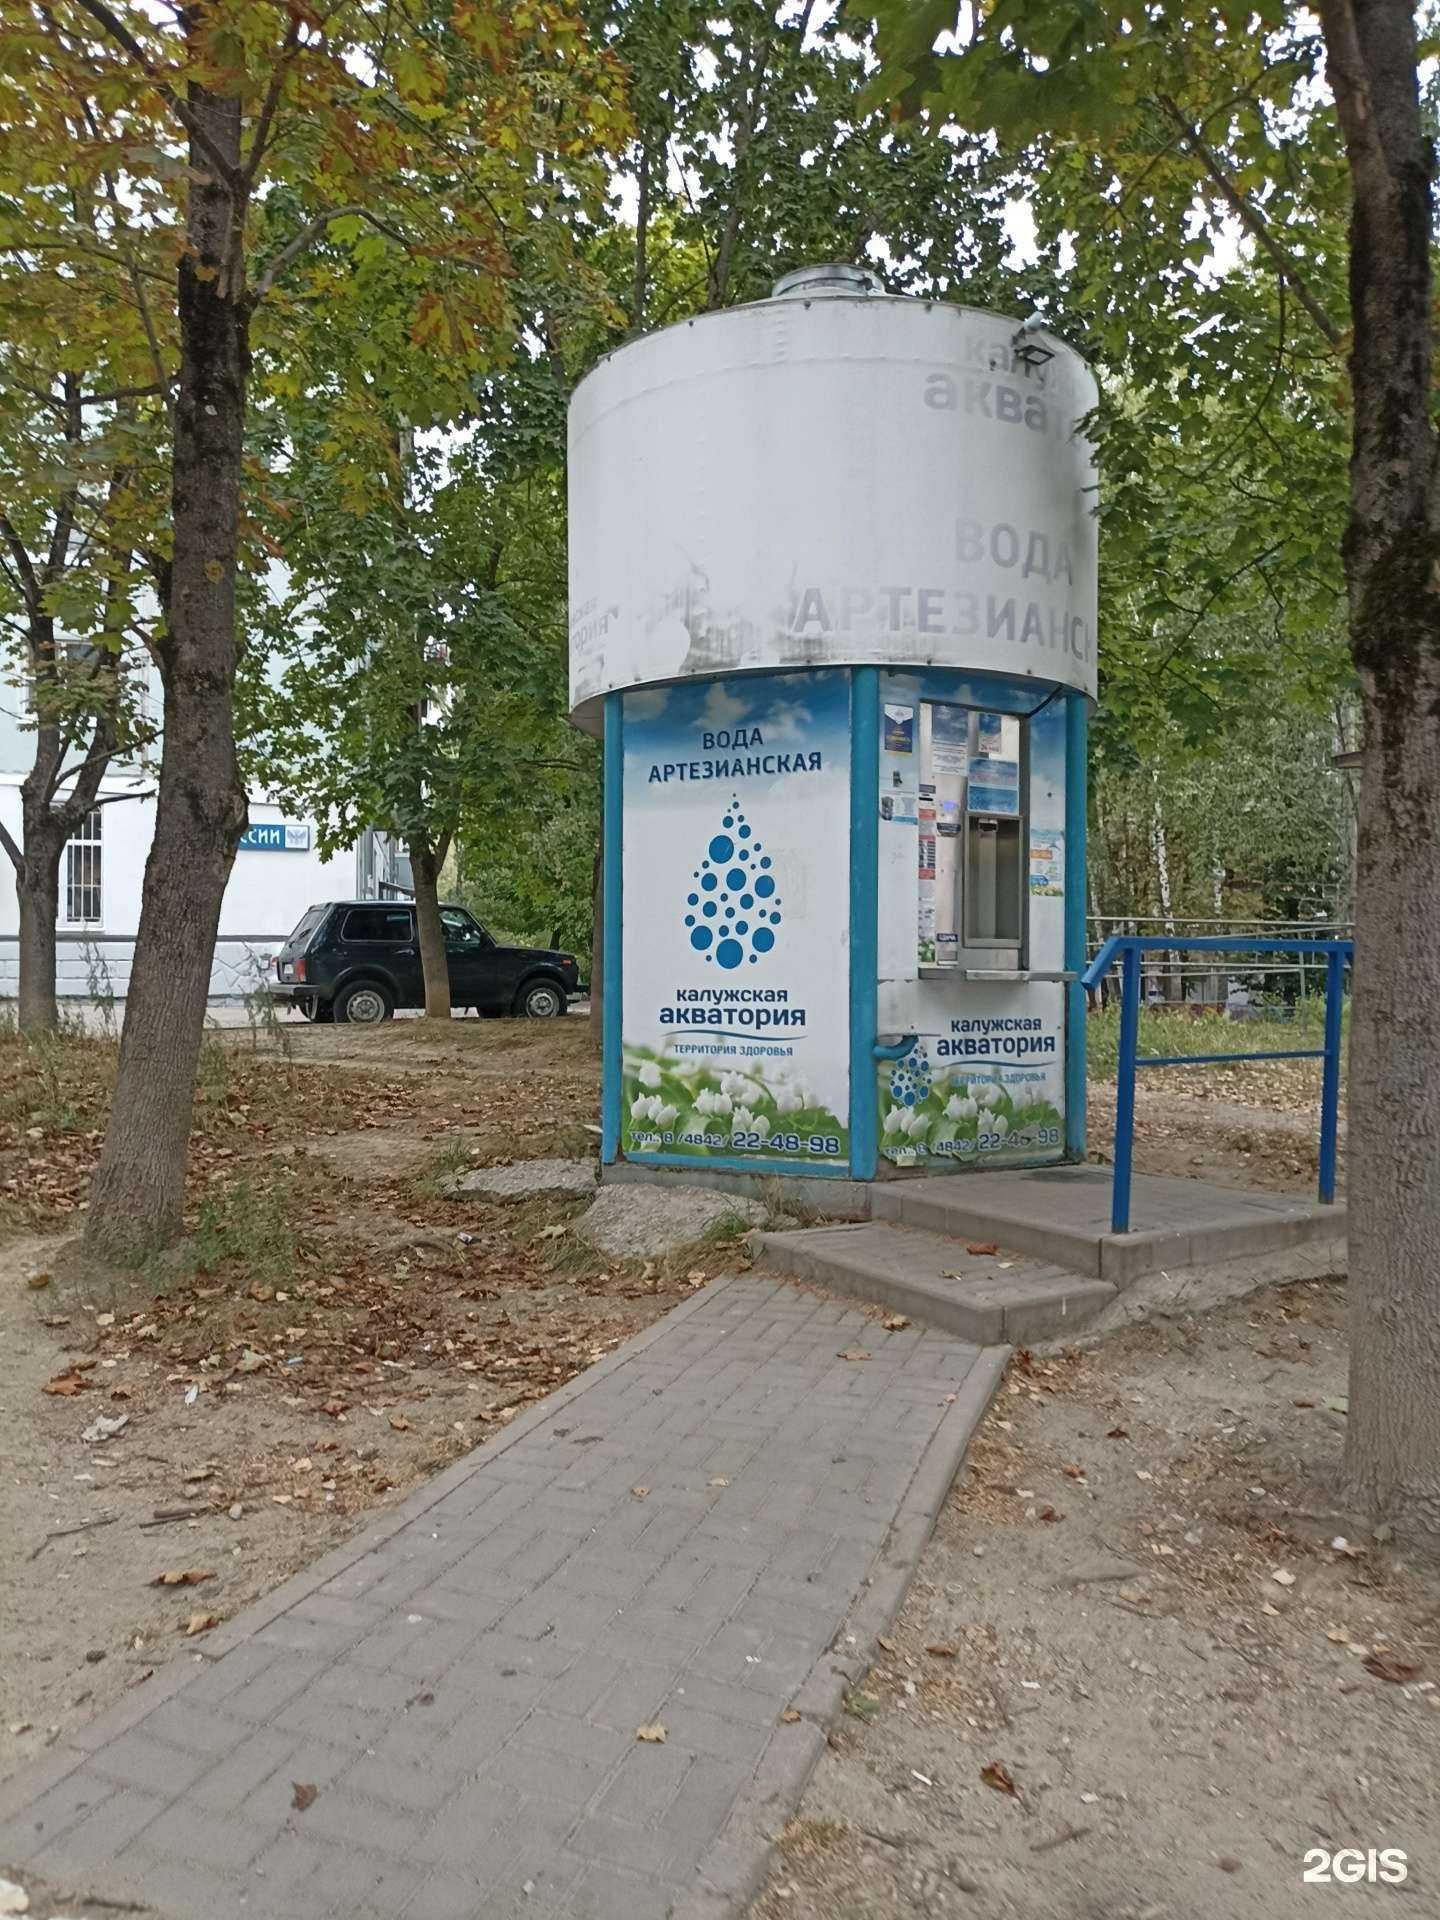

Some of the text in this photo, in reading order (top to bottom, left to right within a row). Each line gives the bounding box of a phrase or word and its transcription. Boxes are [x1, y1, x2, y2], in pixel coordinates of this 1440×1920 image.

[954, 515, 1074, 586] ВОДА
[702, 727, 764, 750] ВОДА
[648, 752, 822, 783] АРТЕЗИАНСКАЯ
[676, 988, 788, 1005] калужская
[659, 1006, 806, 1029] акватория
[951, 1017, 1042, 1036] калужская
[674, 1044, 793, 1057] ТЕРРИТОРИЯ ЗДОРОВЬЯ
[936, 1035, 1056, 1057] акватория
[733, 1131, 840, 1154] 22-48-98
